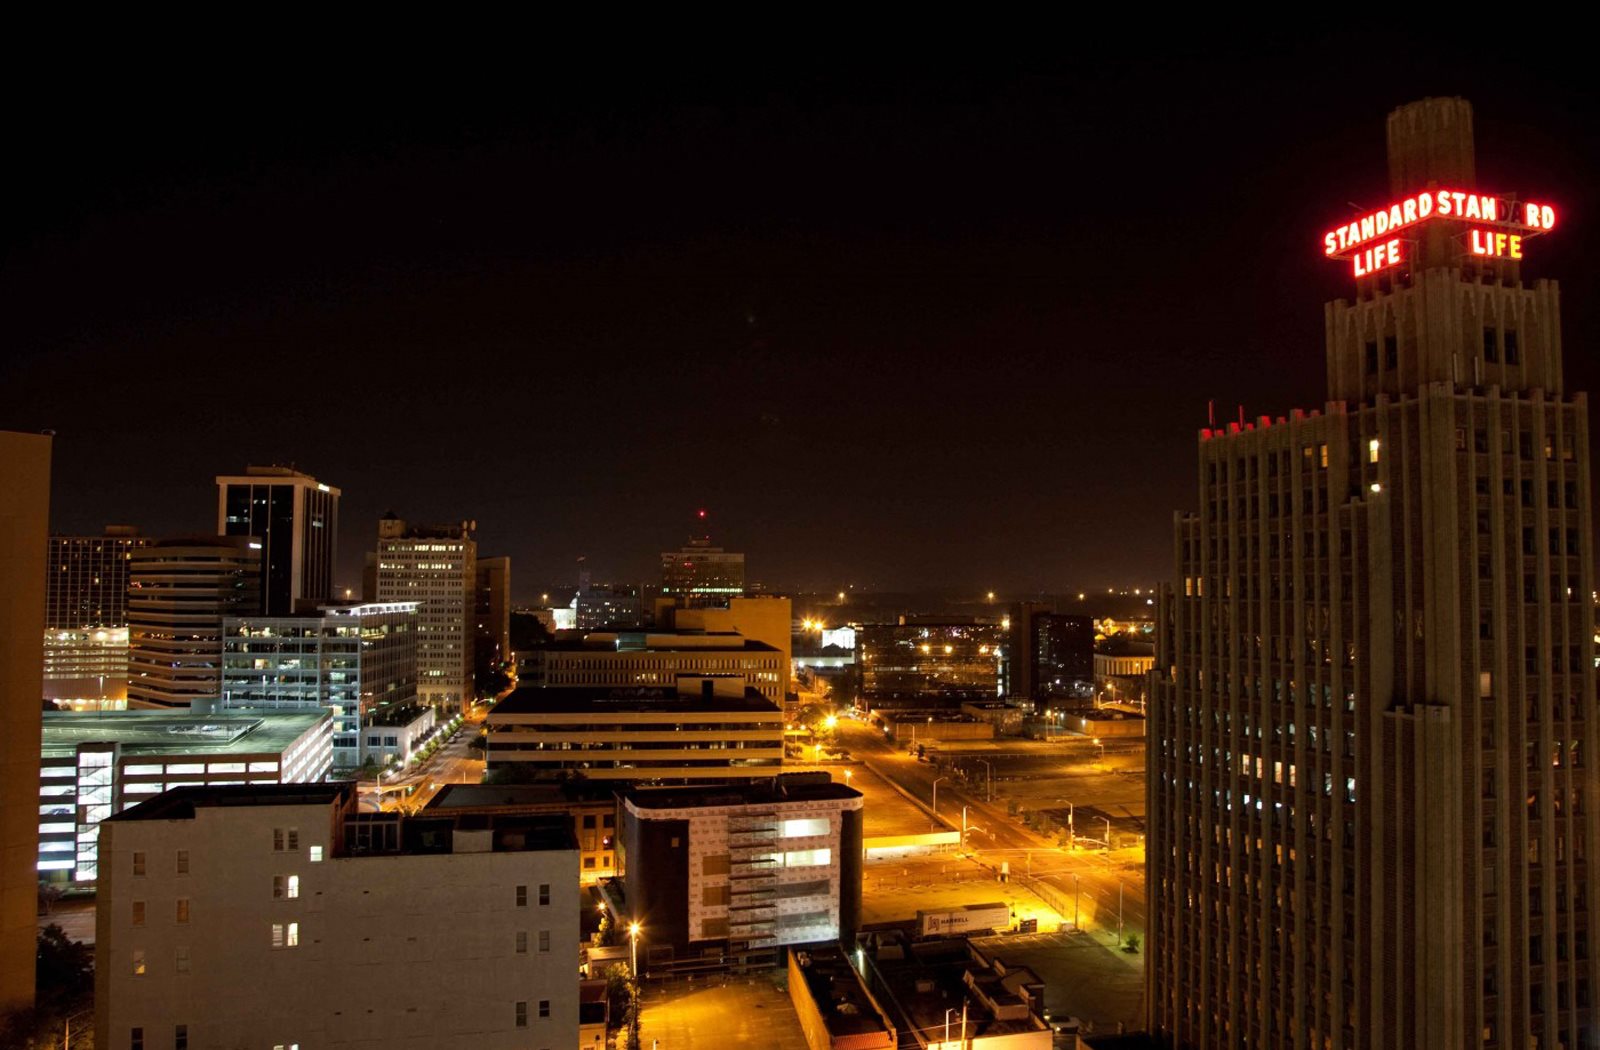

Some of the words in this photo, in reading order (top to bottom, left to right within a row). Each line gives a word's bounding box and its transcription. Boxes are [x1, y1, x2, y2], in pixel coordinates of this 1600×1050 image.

[1325, 192, 1433, 255] STANDARD
[1353, 239, 1400, 277] LIFE
[1472, 230, 1523, 259] LIFE
